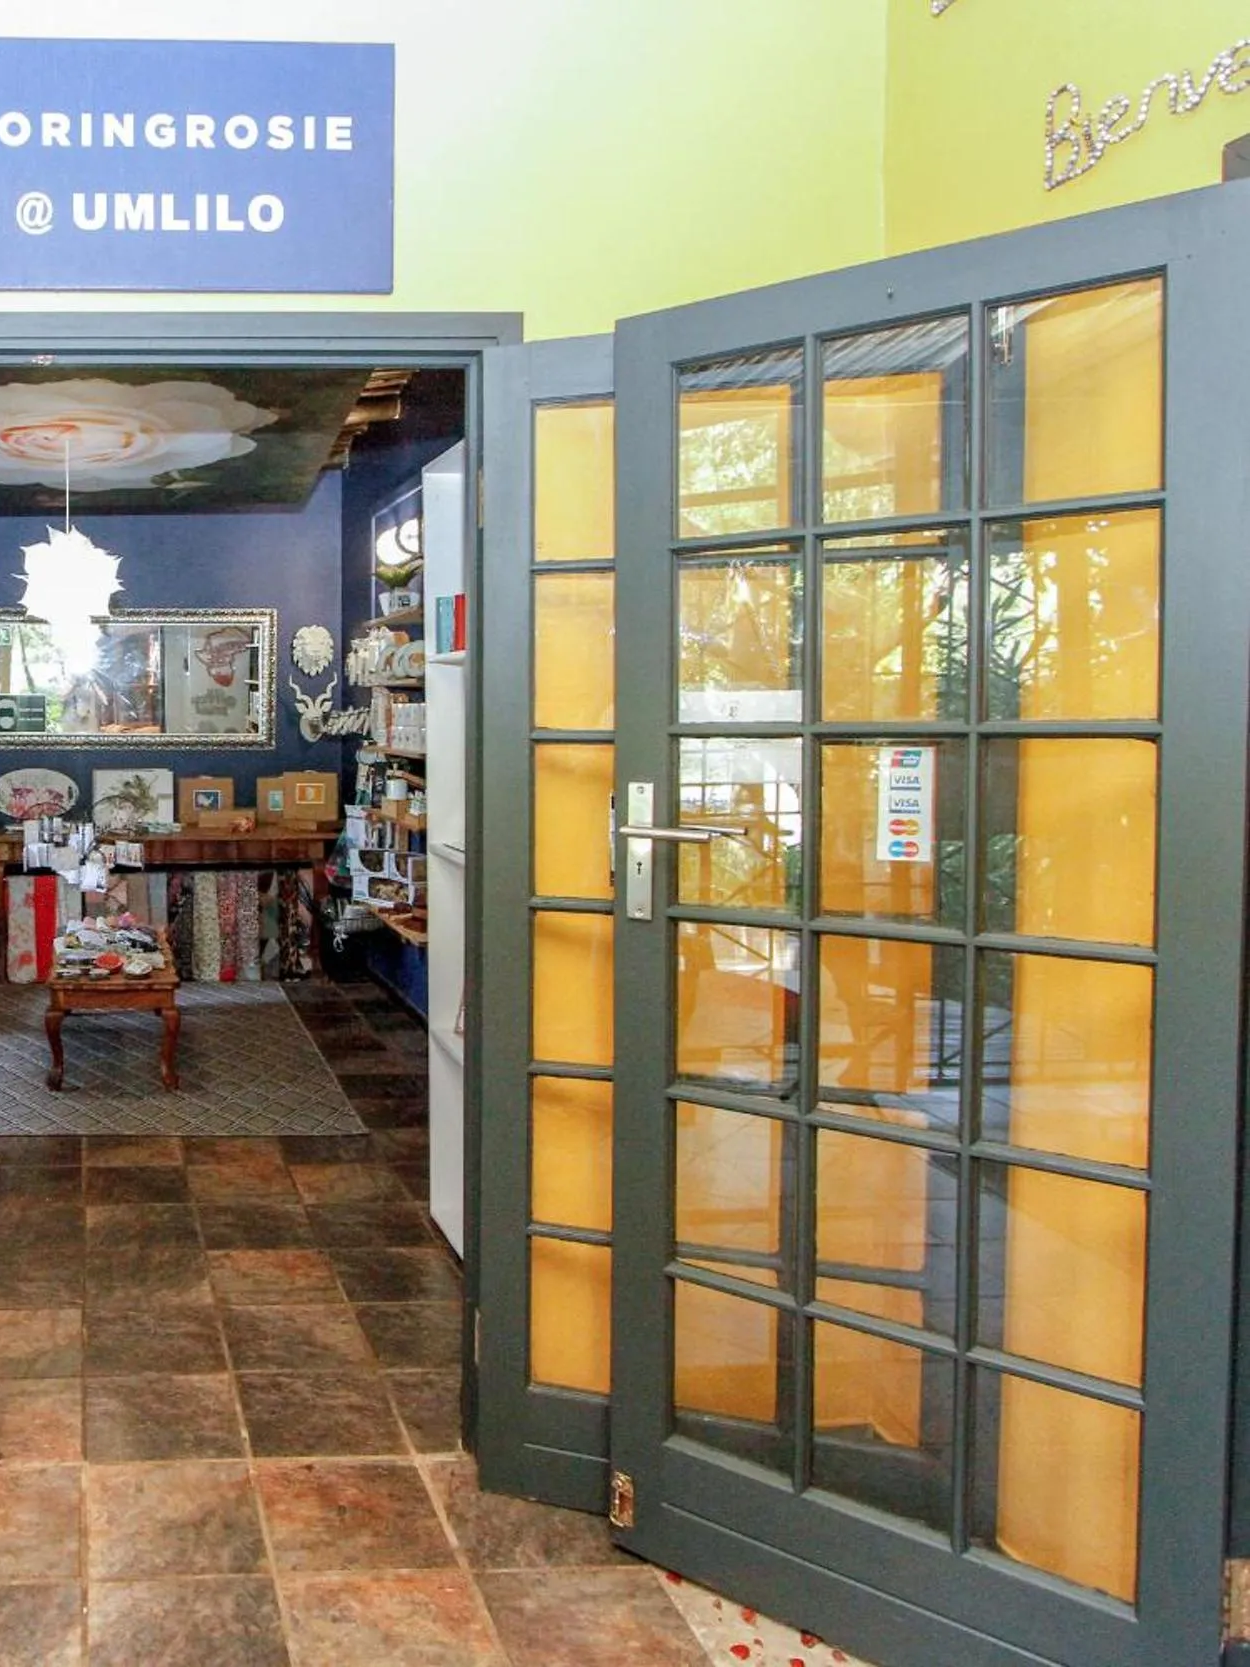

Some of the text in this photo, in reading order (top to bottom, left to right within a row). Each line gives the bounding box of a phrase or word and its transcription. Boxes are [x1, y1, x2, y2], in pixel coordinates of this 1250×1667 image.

[15, 191, 285, 235] @ UMLILO
[893, 775, 920, 785] VISA
[893, 798, 920, 808] VISA
